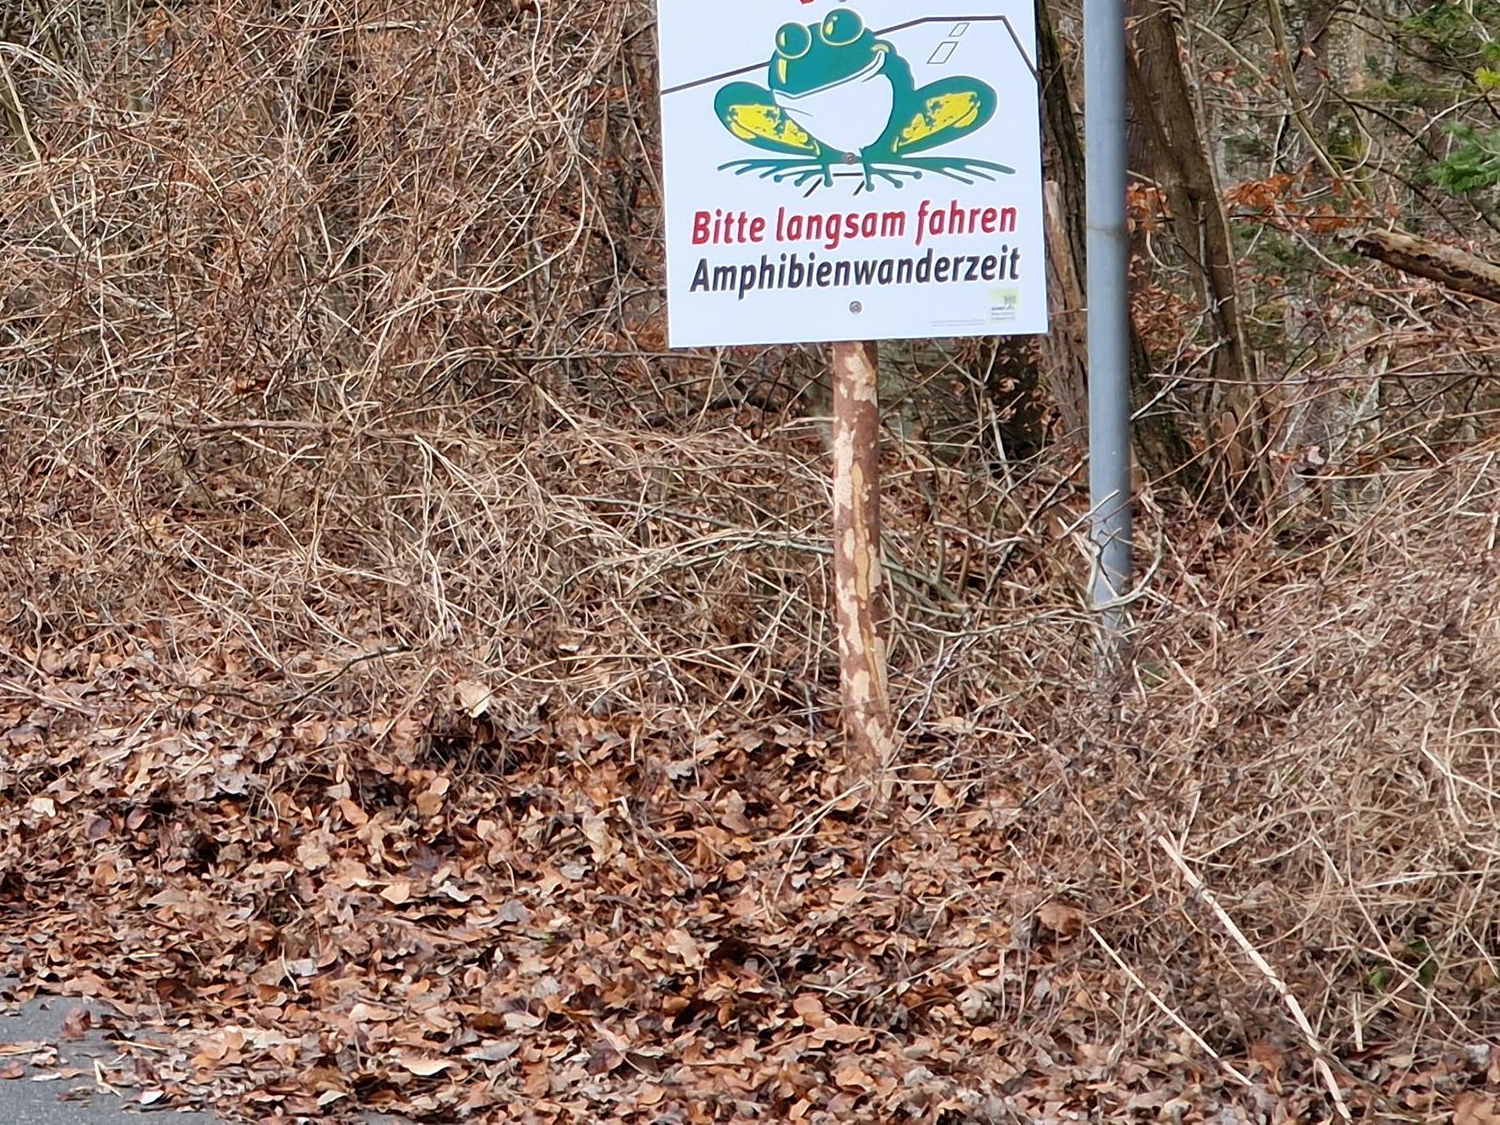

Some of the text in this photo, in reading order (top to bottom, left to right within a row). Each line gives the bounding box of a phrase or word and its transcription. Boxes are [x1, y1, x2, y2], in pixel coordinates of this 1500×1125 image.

[691, 201, 1017, 250] Bitte langsam fahren
[689, 244, 1020, 300] Amphibienwanderzeit
